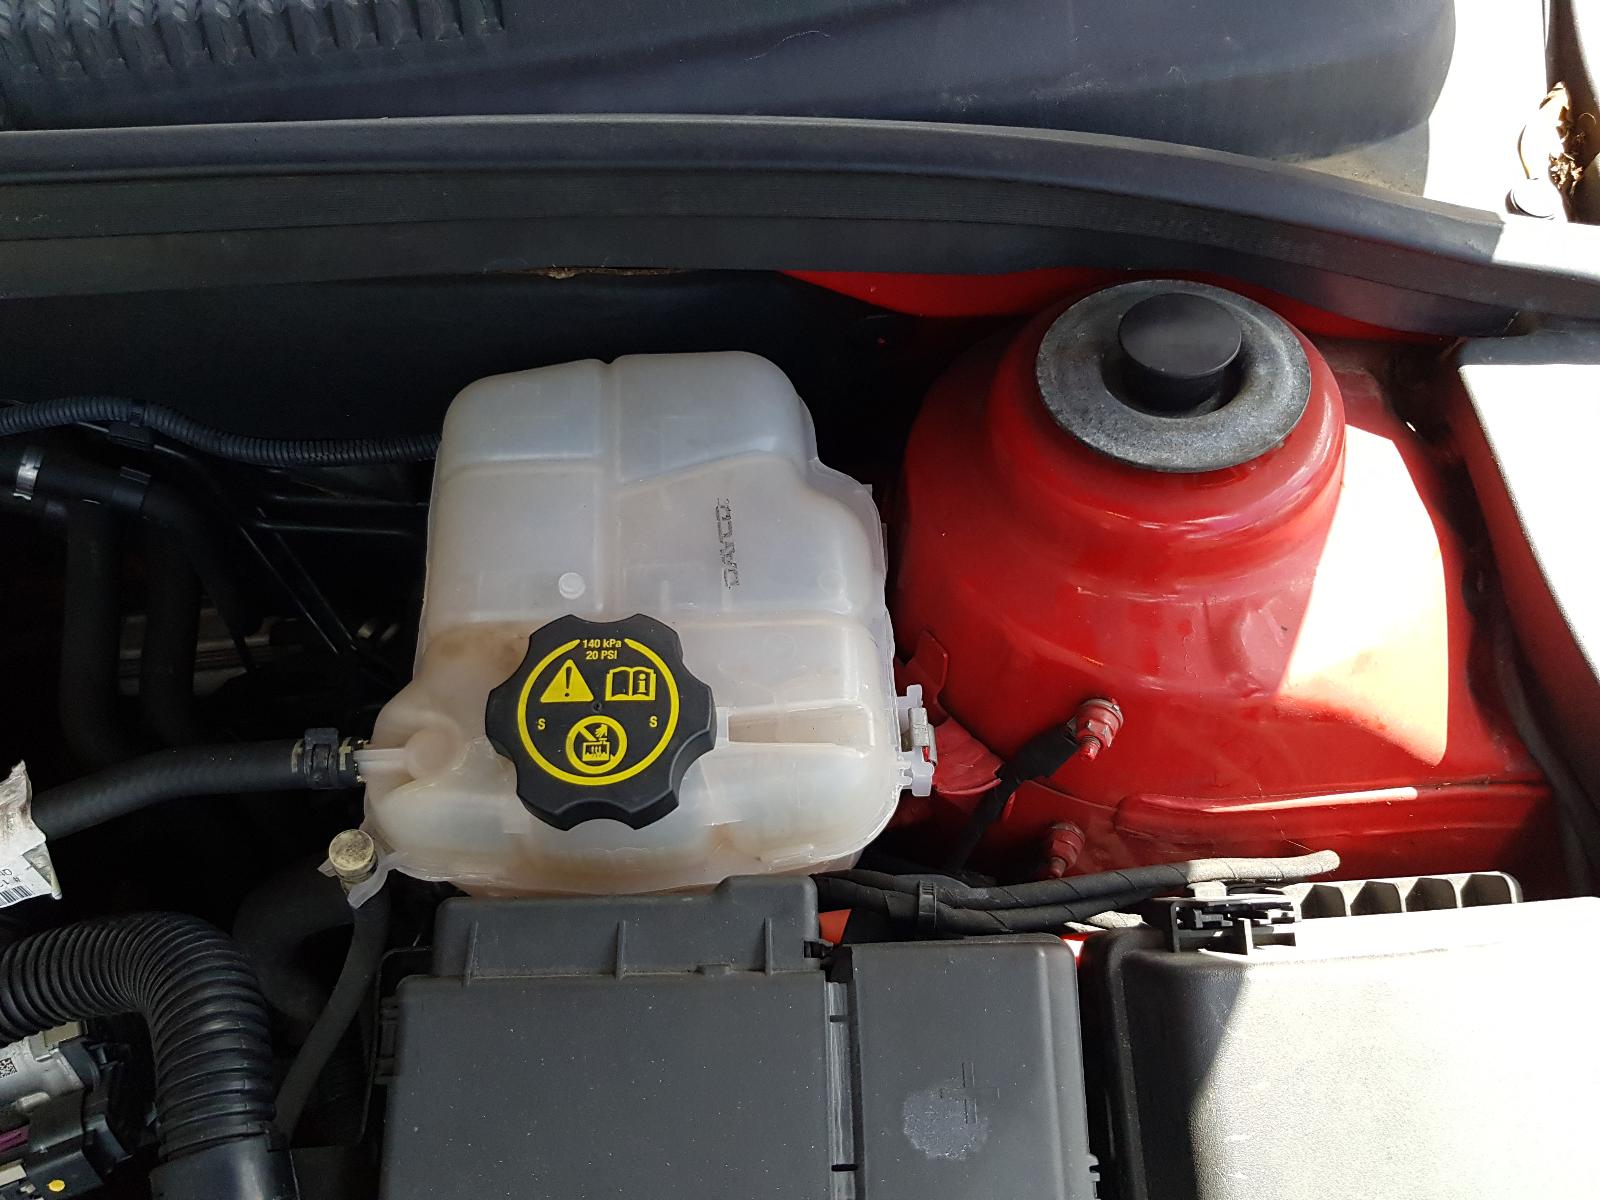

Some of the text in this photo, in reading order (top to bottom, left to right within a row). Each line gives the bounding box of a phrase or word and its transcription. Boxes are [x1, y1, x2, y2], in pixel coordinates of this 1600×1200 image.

[582, 638, 622, 648] 140 kPa
[585, 650, 618, 660] 20 PSI
[537, 718, 546, 730] S
[649, 715, 658, 728] S
